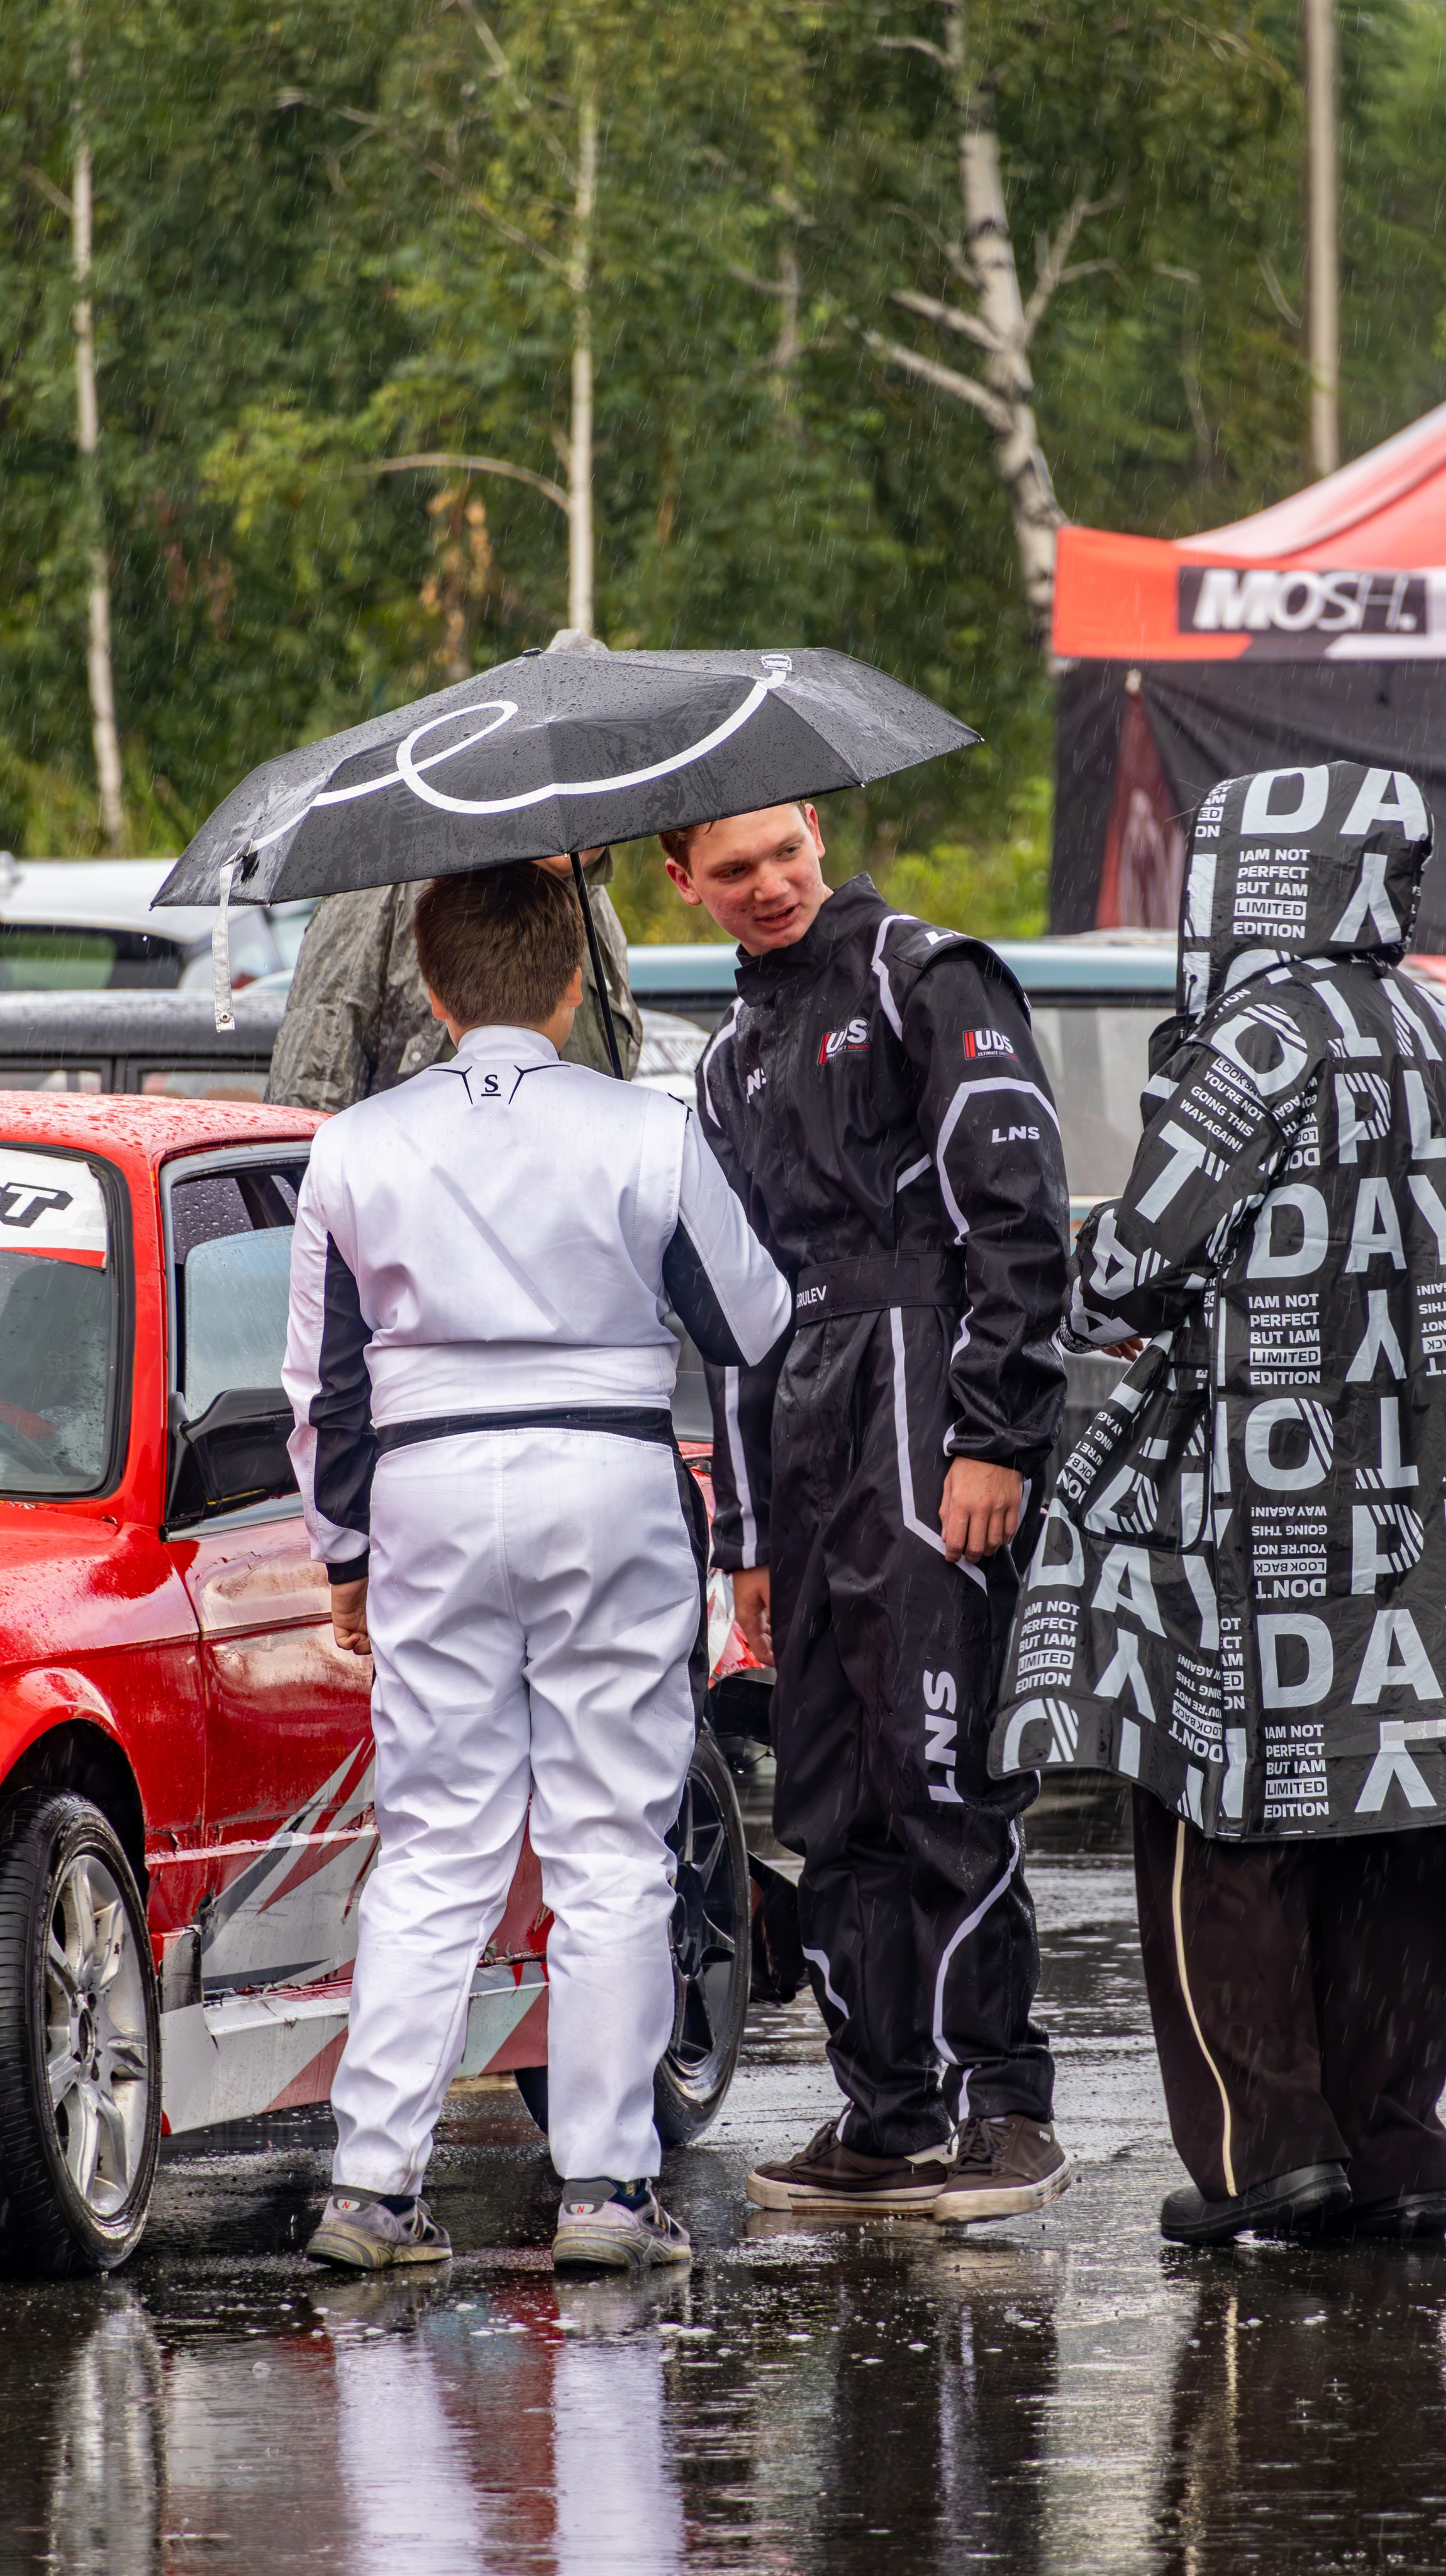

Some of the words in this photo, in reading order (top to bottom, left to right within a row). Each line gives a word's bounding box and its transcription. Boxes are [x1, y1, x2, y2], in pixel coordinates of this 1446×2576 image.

[1240, 848, 1271, 862] IAM
[1275, 848, 1310, 861] NOT
[1237, 865, 1310, 879] PERFECT
[1236, 881, 1270, 894] BUT
[1274, 882, 1308, 896] IAM
[1237, 901, 1304, 916] LIMITED
[1233, 921, 1306, 938] EDITION
[826, 1019, 868, 1054] US
[975, 1030, 1014, 1054] UDS
[1215, 1058, 1245, 1085] LOOK
[1204, 1070, 1243, 1104] YOU'RE
[1240, 1099, 1265, 1121] NOT
[1191, 1085, 1228, 1116] GOING
[1227, 1112, 1254, 1137] THIS
[1179, 1099, 1207, 1122] WAY
[1203, 1119, 1243, 1152] AGAIN!
[991, 1126, 1040, 1143] LNS
[1249, 1296, 1280, 1309] IAM
[1285, 1293, 1319, 1307] NOT
[1250, 1312, 1320, 1327] PERFECT
[1250, 1331, 1284, 1345] BUT
[1289, 1329, 1320, 1343] IAM
[1252, 1350, 1319, 1363] LIMITED
[1250, 1370, 1321, 1385] EDITION
[1251, 1506, 1296, 1517] AGAIN!
[1297, 1506, 1327, 1516] WAY
[1252, 1525, 1282, 1536] THIS
[1286, 1524, 1328, 1536] GOING
[1252, 1544, 1278, 1555] NOT
[1281, 1543, 1327, 1555] YOU'RE
[1256, 1563, 1288, 1573] BACK
[1290, 1562, 1325, 1572] LOOK
[1255, 1578, 1326, 1599] DON'T
[1024, 1602, 1042, 1619] IAM
[1046, 1601, 1080, 1616] NOT
[1021, 1617, 1079, 1636] PERFECT
[1019, 1635, 1041, 1653] BUT
[1043, 1633, 1077, 1648] IAM
[1020, 1653, 1071, 1672] LIMITED
[1177, 1653, 1214, 1677] AGAIN!
[1015, 1672, 1072, 1694] EDITION
[1176, 1671, 1196, 1692] THIS
[1174, 1687, 1192, 1707] NOT
[1175, 1705, 1196, 1726] BACK
[923, 1670, 964, 1804] LNS
[1265, 1726, 1286, 1739] IAM
[1291, 1724, 1324, 1738] NOT
[1168, 1719, 1223, 1763] DON'T
[1266, 1743, 1325, 1758] PERFECT
[1266, 1762, 1291, 1775] BUT
[1294, 1759, 1326, 1774] IAM
[1267, 1780, 1325, 1796] LIMITED
[1264, 1802, 1329, 1818] EDITION
